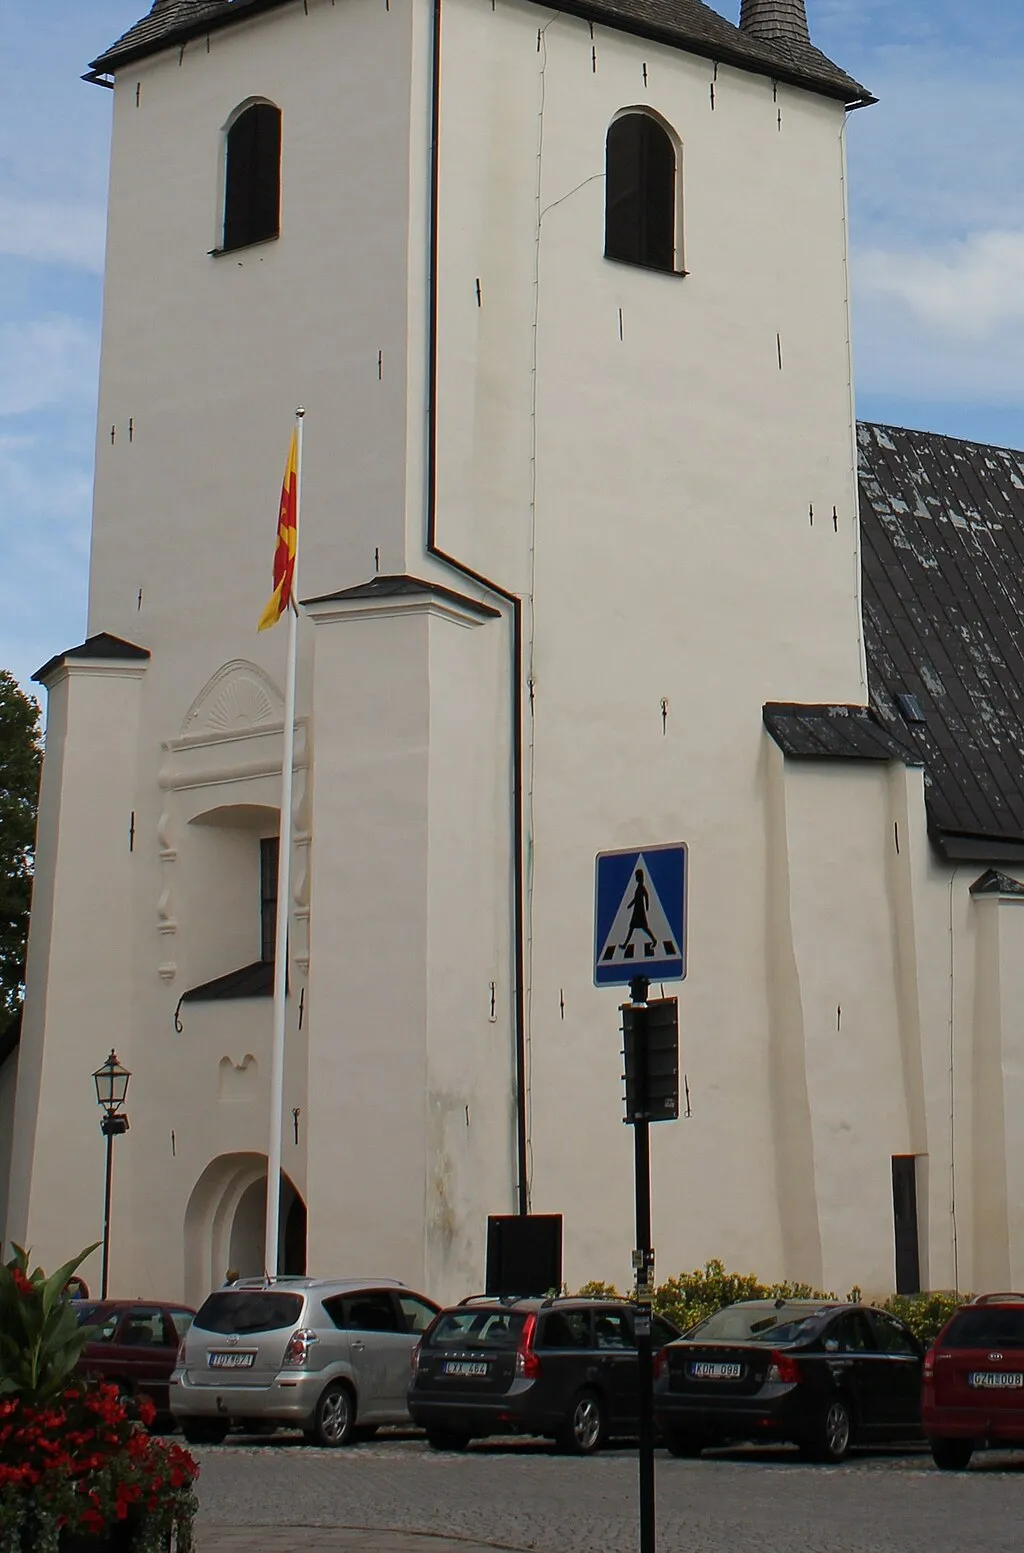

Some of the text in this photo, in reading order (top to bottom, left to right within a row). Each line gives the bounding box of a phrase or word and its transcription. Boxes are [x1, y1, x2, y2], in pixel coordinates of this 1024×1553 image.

[720, 1364, 739, 1375] 098
[974, 1373, 1021, 1385] GZM 008
